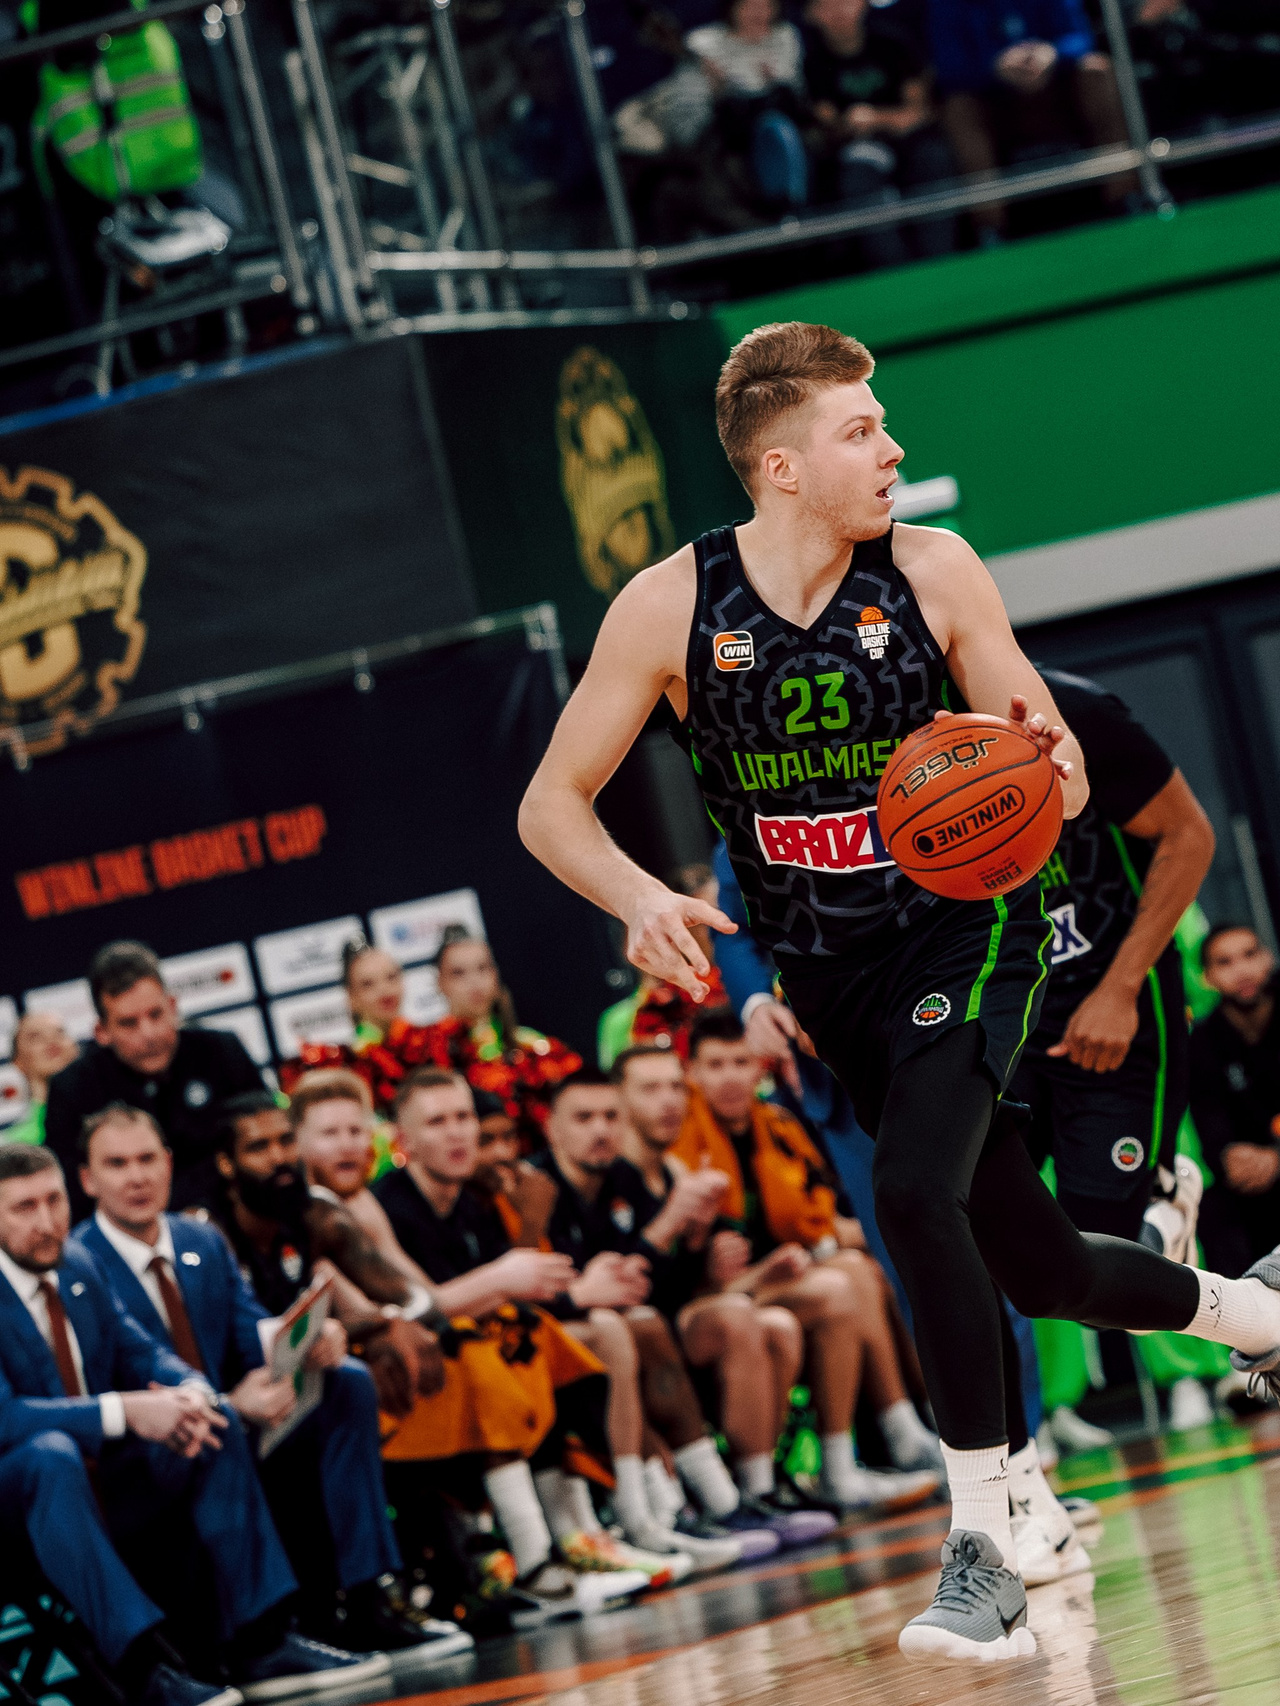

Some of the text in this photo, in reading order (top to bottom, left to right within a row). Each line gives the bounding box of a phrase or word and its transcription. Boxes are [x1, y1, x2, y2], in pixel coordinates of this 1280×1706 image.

[857, 622, 890, 638] WINLINE
[861, 634, 889, 649] BASKET
[723, 644, 751, 658] WIN
[869, 646, 885, 660] CUP
[780, 671, 850, 735] 23
[732, 737, 902, 791] URALMAS
[890, 737, 999, 798] JÖGEL
[264, 805, 327, 863] CUP
[935, 792, 1018, 847] WINLINE
[984, 865, 1022, 890] FIBA
